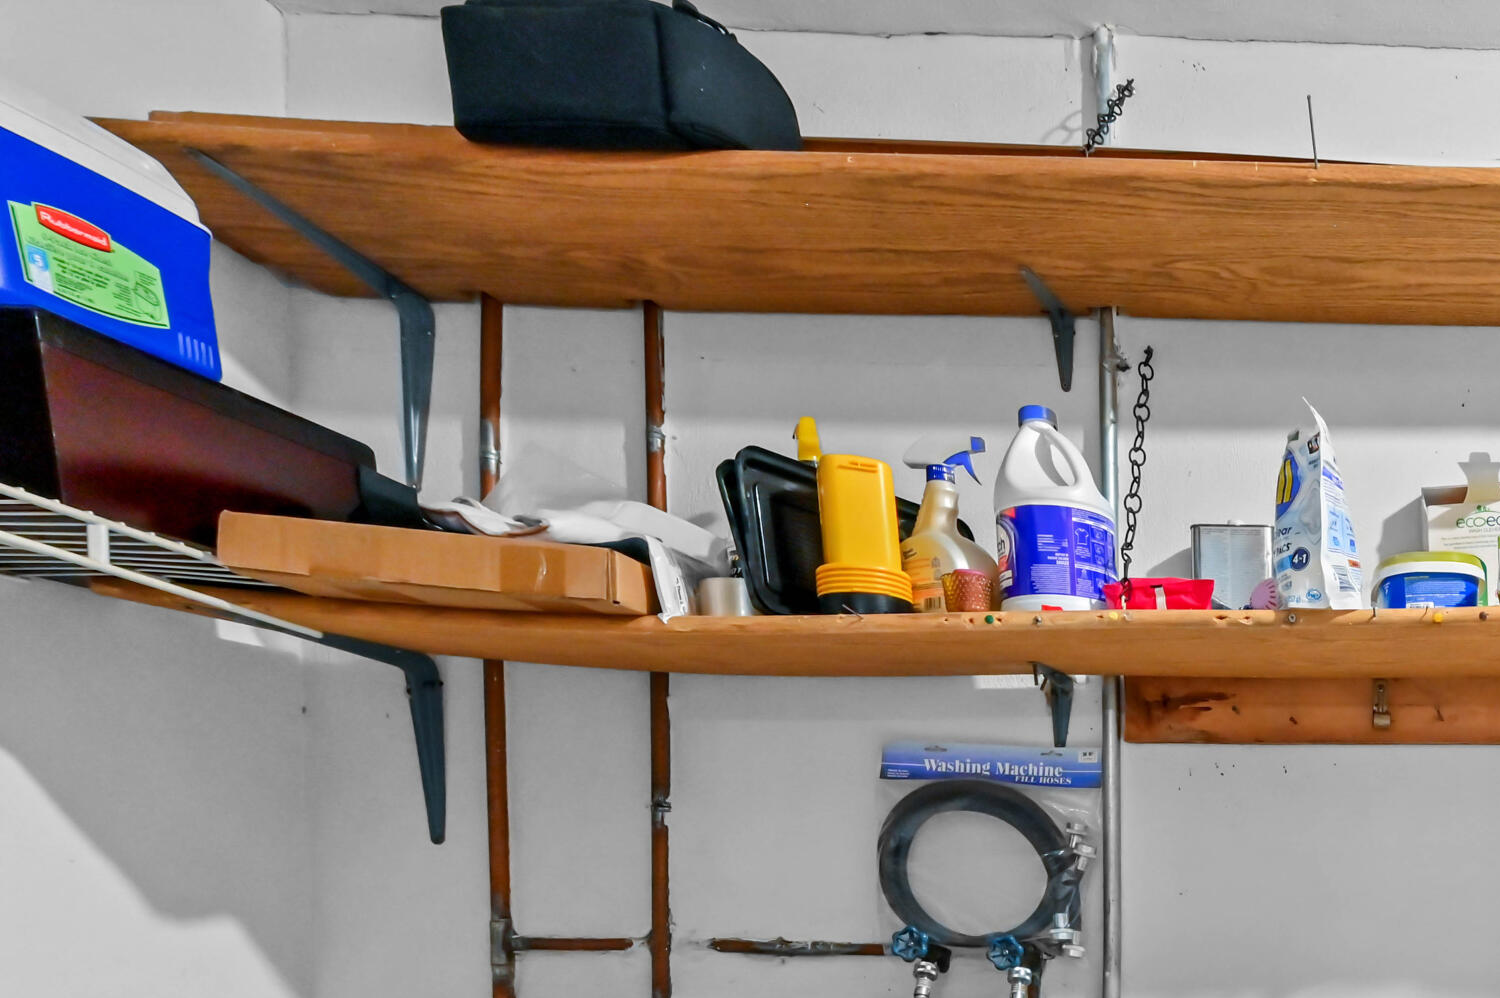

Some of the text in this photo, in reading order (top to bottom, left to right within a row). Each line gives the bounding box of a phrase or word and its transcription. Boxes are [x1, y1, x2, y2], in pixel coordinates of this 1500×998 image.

[39, 210, 108, 247] Rubbermaid
[923, 758, 990, 776] Washing
[996, 762, 1063, 777] Machine
[1015, 776, 1072, 785] FILL HOSES
